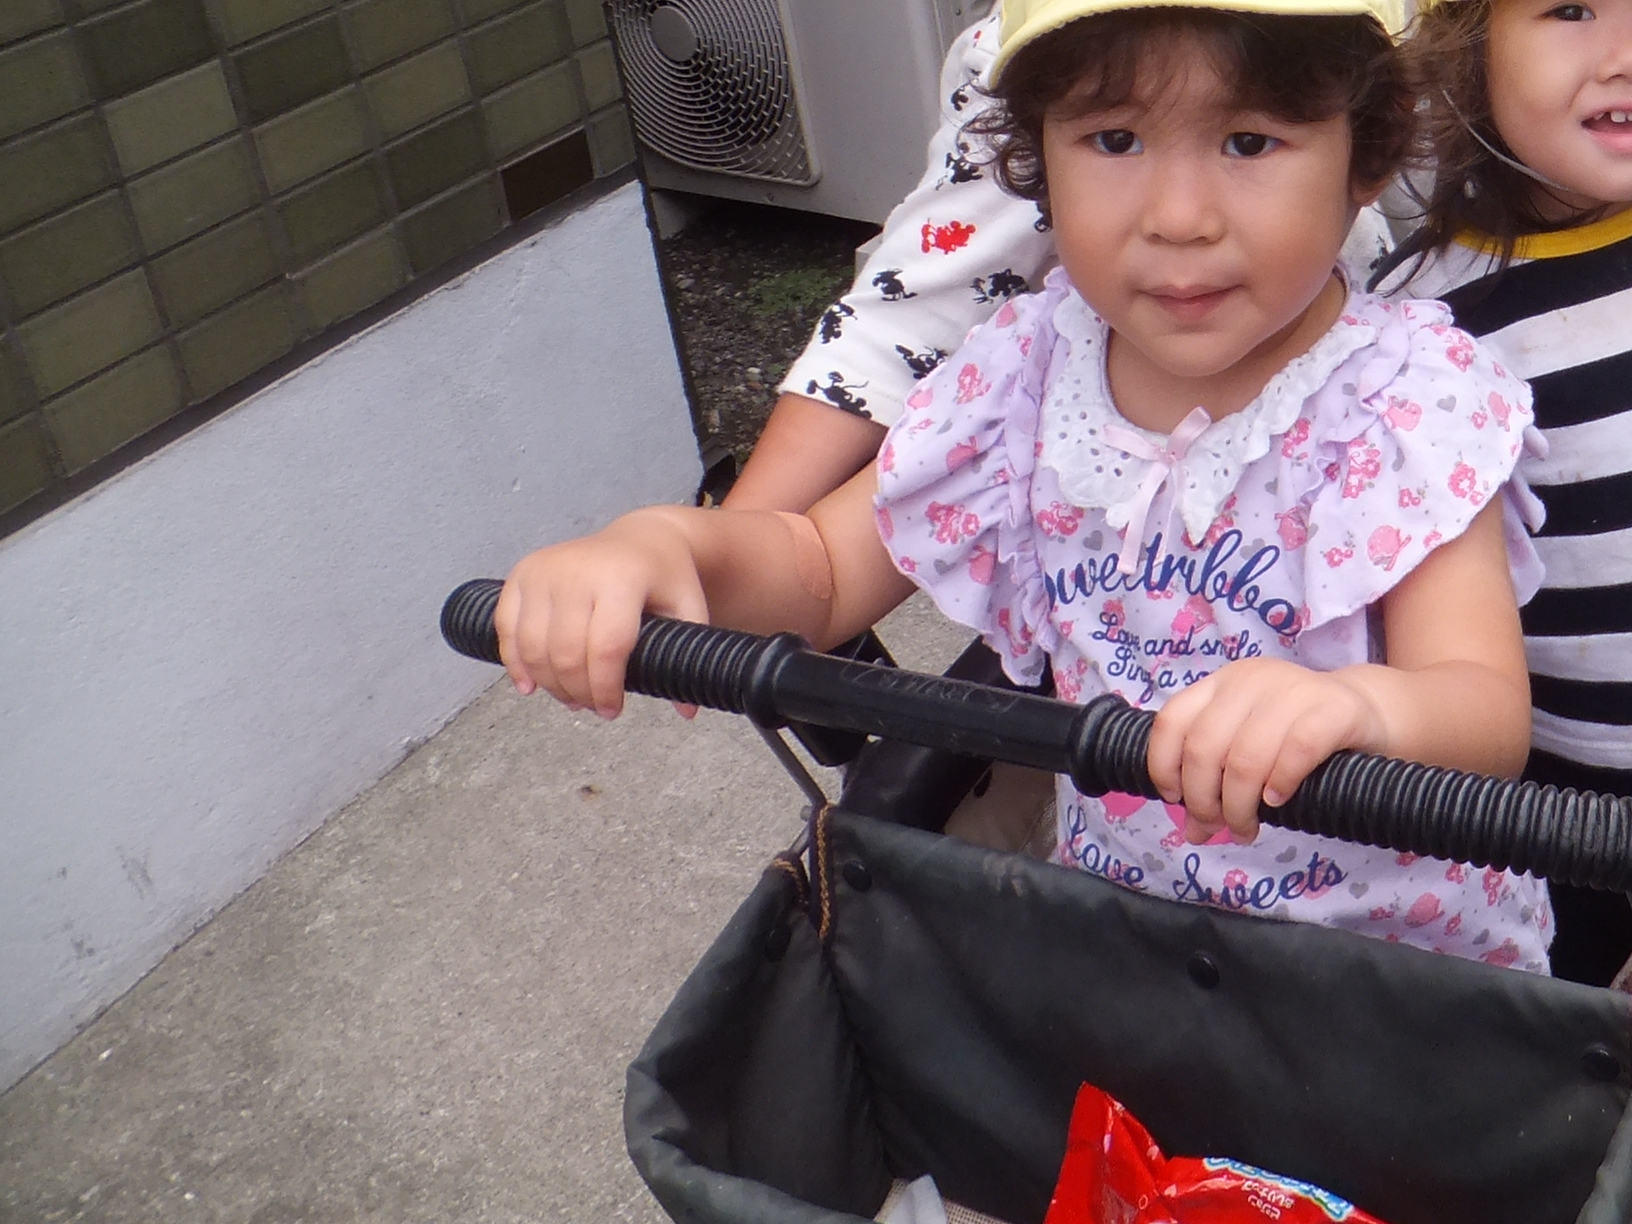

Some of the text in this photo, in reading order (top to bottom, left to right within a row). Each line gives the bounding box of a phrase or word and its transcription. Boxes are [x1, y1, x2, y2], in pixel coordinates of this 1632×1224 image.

[1144, 625, 1196, 656] and
[1158, 669, 1178, 689] a
[1067, 804, 1348, 910] Love Sweets
